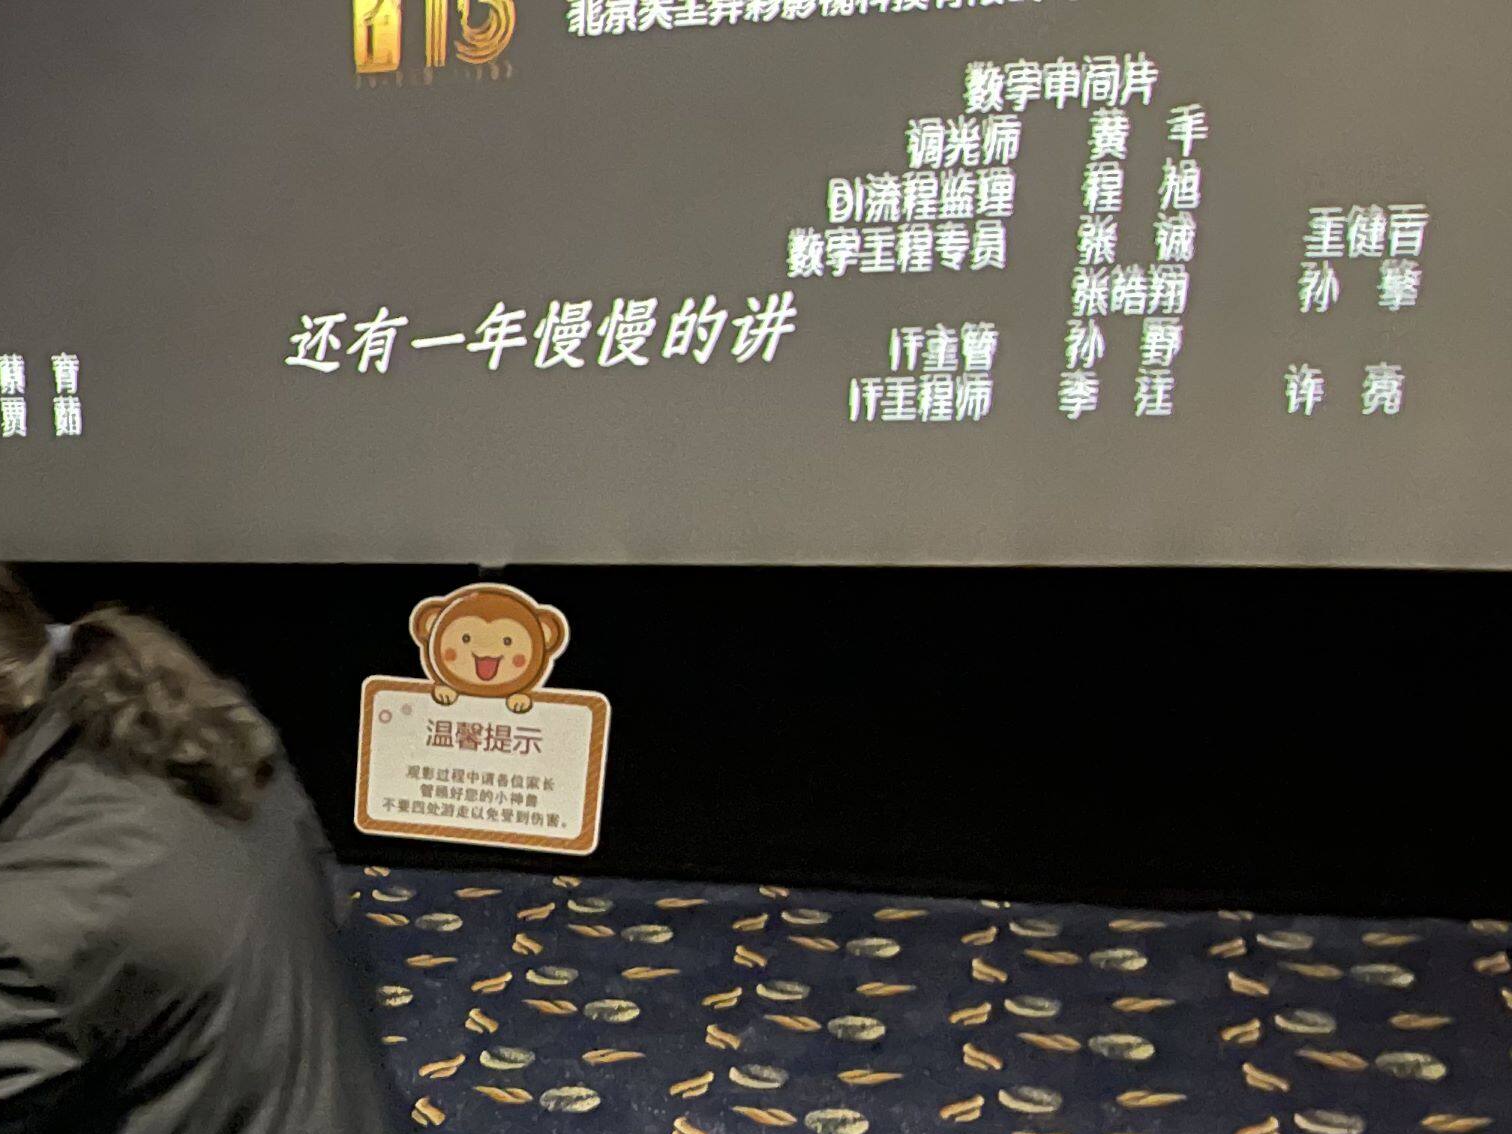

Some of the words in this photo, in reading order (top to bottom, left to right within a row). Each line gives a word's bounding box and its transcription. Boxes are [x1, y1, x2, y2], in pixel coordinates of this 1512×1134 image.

[964, 52, 1160, 114] 数字中间片
[904, 114, 1022, 169] 调光师
[786, 219, 1007, 278] 数字工程专员
[284, 290, 798, 374] 还有一年慢慢的讲
[425, 717, 544, 755] 温馨提示
